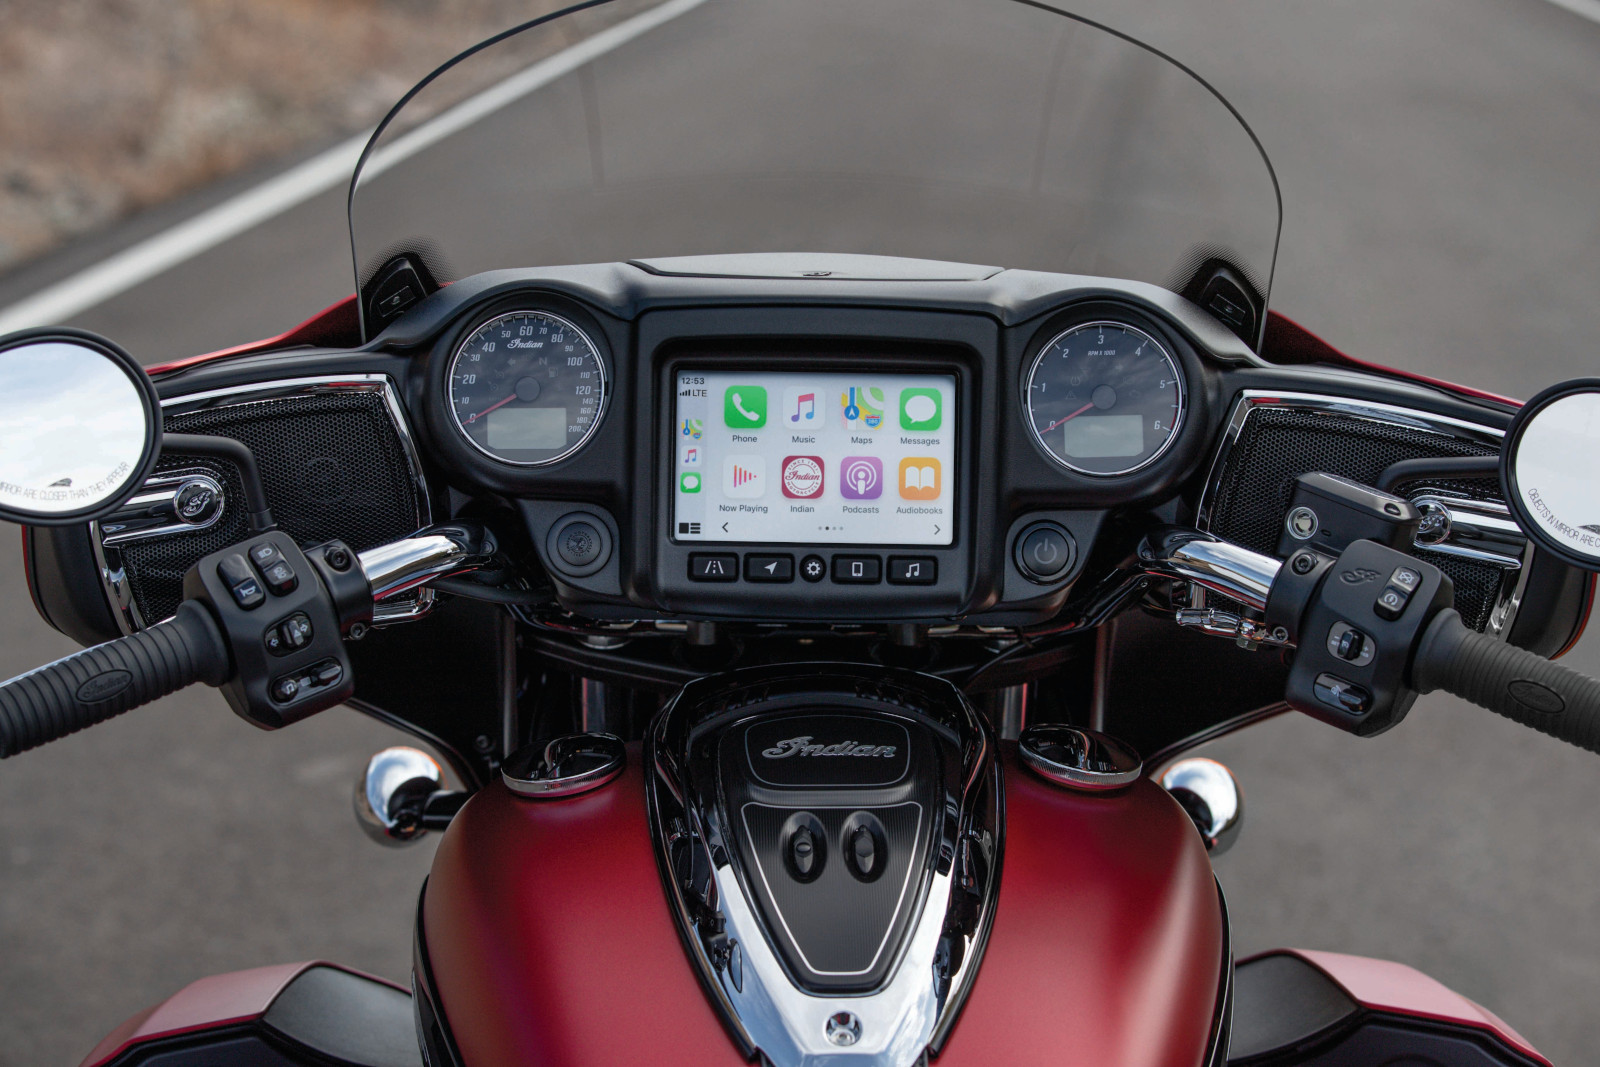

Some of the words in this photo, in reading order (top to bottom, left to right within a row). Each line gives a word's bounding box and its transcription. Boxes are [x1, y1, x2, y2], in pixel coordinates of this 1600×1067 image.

[501, 330, 511, 338] 50
[519, 326, 533, 336] 60
[539, 327, 547, 335] 70
[551, 334, 563, 343] 80
[1098, 335, 1104, 344] 3
[482, 342, 495, 352] 40
[507, 338, 543, 349] Indian
[1062, 349, 1069, 358] 2
[1135, 347, 1141, 357] 4
[470, 354, 480, 362] 30
[567, 357, 582, 366] 100
[463, 374, 476, 384] 20
[682, 377, 705, 385] 12:53
[1041, 382, 1046, 392] 1
[1160, 380, 1165, 389] 5
[575, 386, 591, 395] 120
[692, 389, 707, 397] LTE
[568, 425, 582, 433] 200
[1154, 420, 1161, 430] 6
[732, 435, 758, 443] Phone
[791, 436, 816, 444] Music
[851, 436, 873, 446] Maps
[900, 437, 940, 446] Messages
[785, 470, 820, 481] Indian
[719, 505, 737, 513] Now
[739, 505, 768, 514] Playing
[790, 505, 815, 513] Indian
[842, 505, 880, 514] Podcasts
[896, 506, 943, 515] Audiobooks
[1528, 488, 1550, 518] OBJECTS
[1547, 515, 1557, 525] IN
[1580, 534, 1595, 546] ARE
[762, 735, 897, 760] Indian
